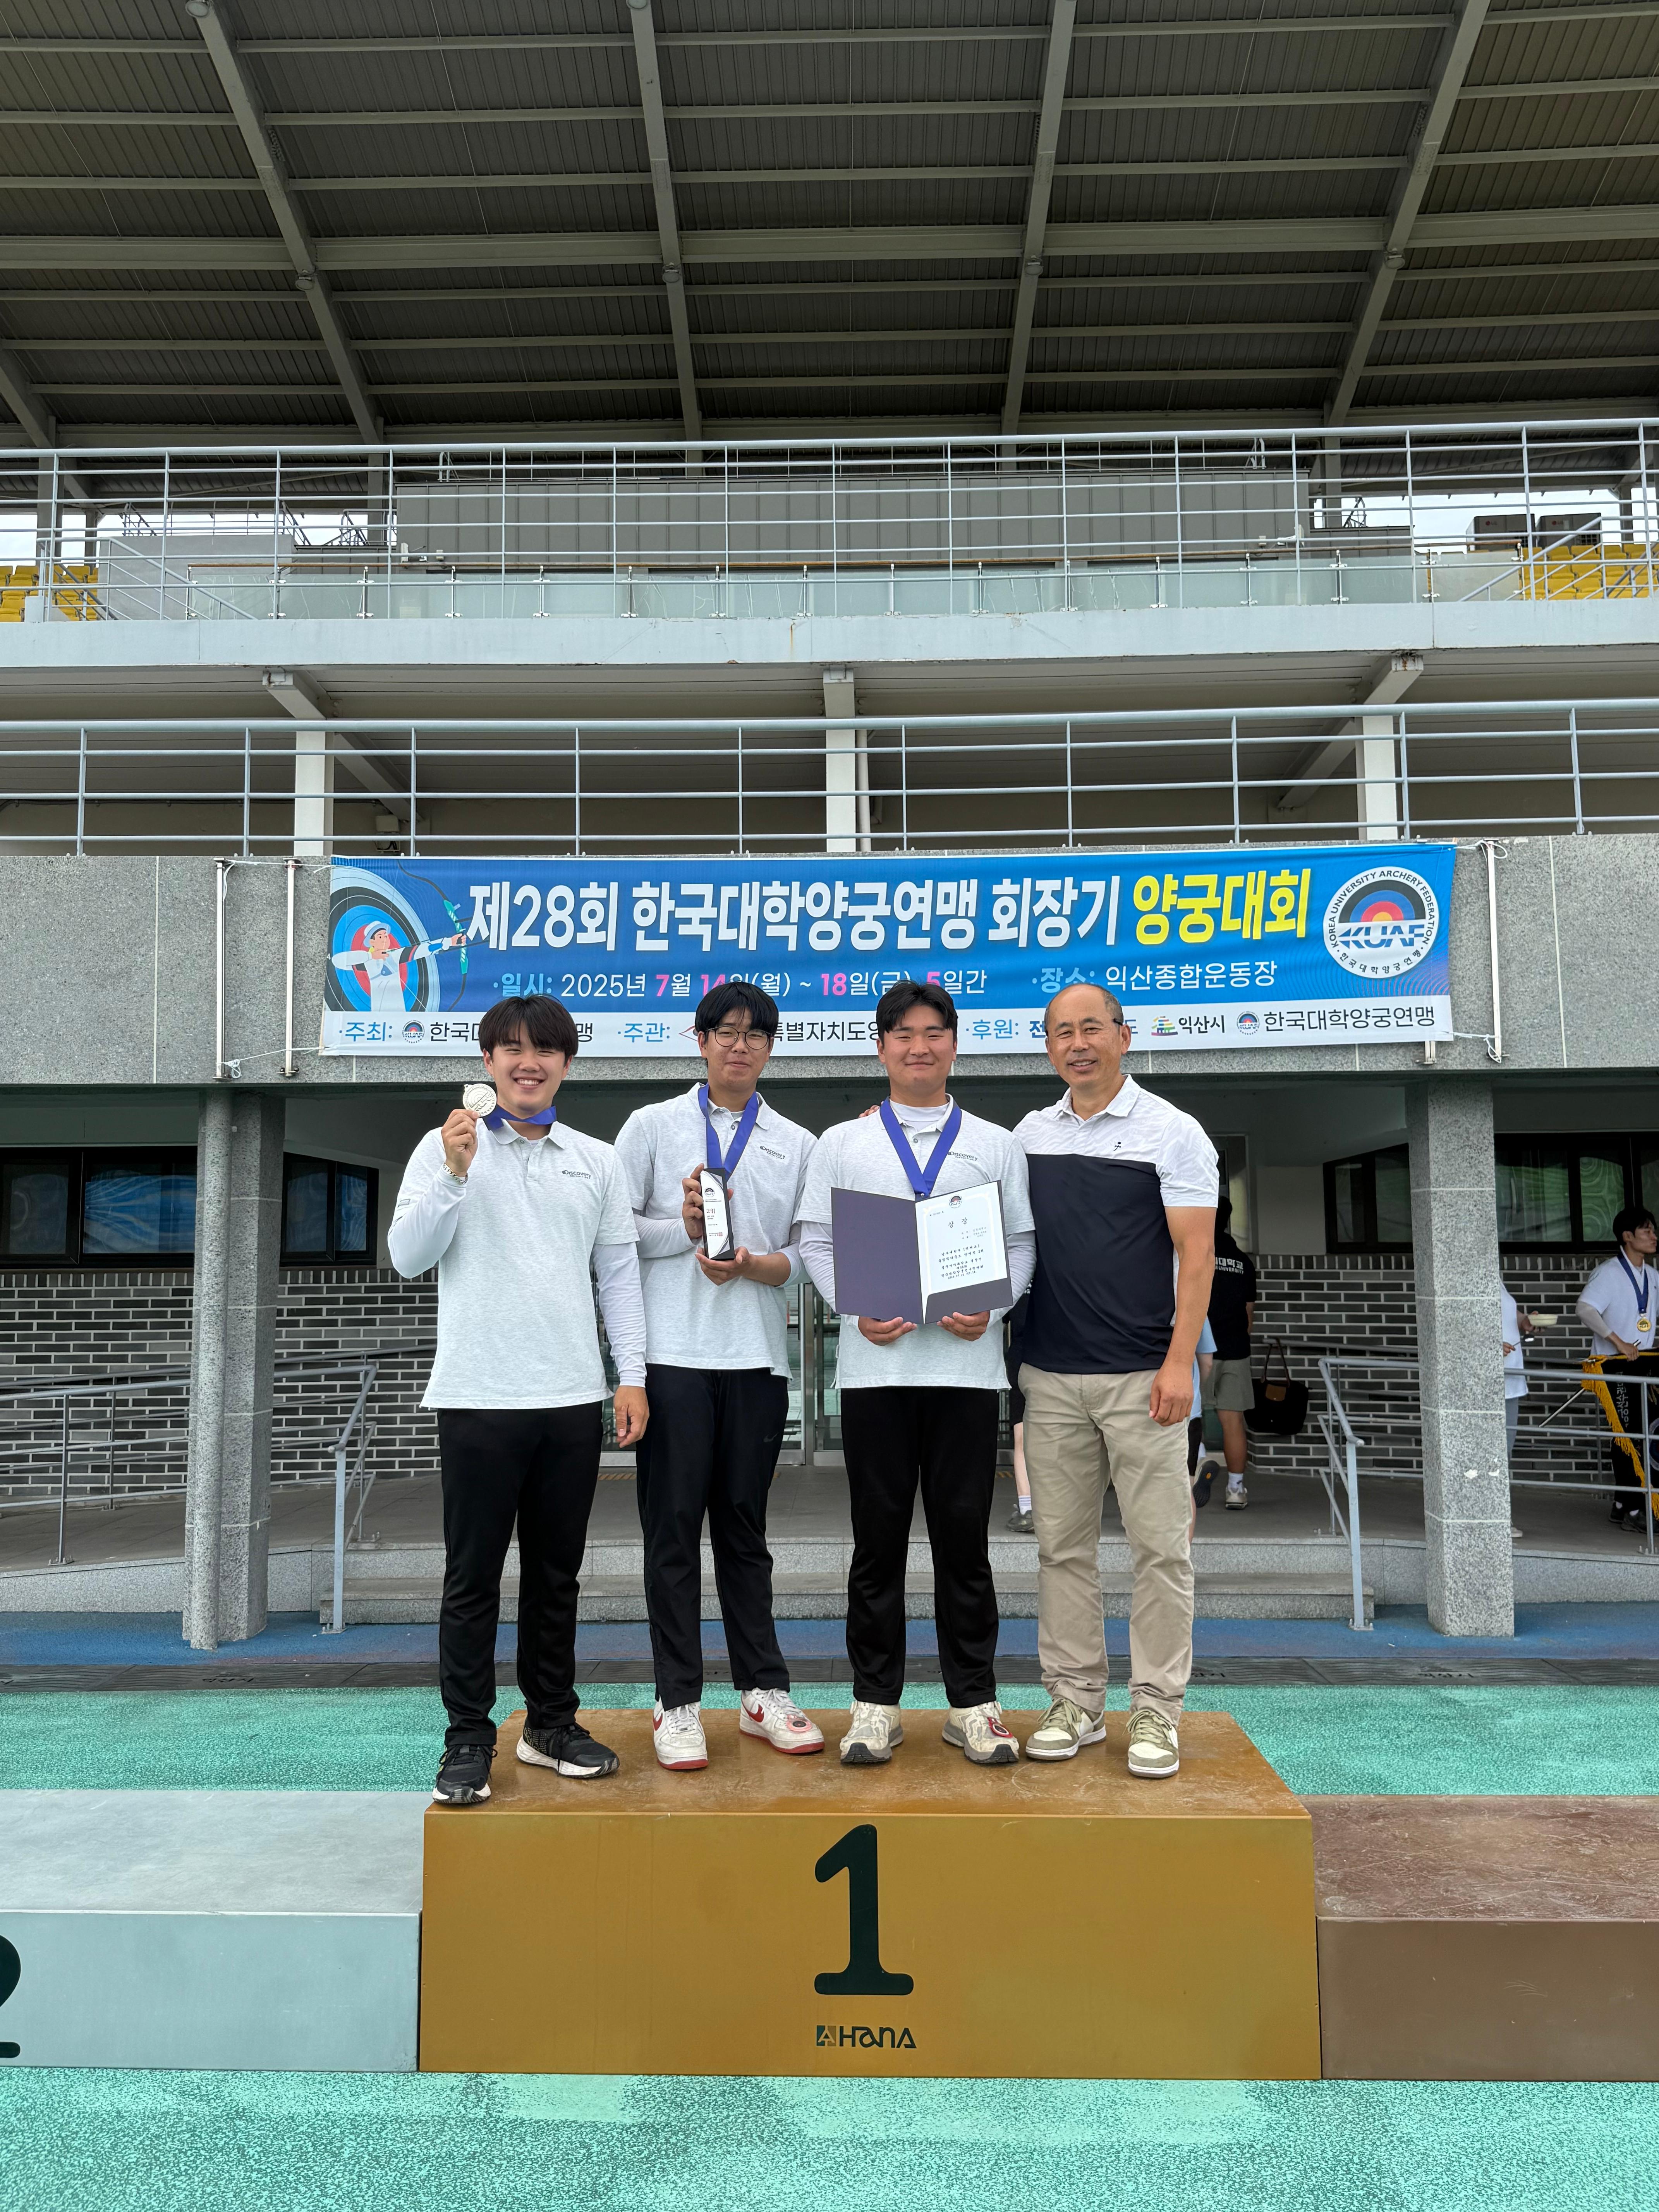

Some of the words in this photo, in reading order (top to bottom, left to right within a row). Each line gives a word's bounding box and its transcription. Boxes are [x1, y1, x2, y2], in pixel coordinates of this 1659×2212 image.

[1331, 872, 1376, 914] UNIVERSITY
[1379, 870, 1423, 886] ARCHERY
[467, 881, 618, 951] 제28회
[633, 879, 977, 951] 한국대학양궁연맹
[988, 876, 1120, 947] 회장기
[1133, 868, 1310, 945] 양궁대회
[1420, 886, 1435, 945] FEDERATION
[1328, 916, 1339, 948] KOREA
[1338, 924, 1425, 950] KUAF
[561, 974, 646, 998] 2025년
[656, 974, 691, 997] 7월
[1106, 961, 1278, 991] 익산종합운동장
[1179, 1015, 1225, 1034] 익산시
[1264, 1007, 1435, 1033] 한국대학양궁연맹
[814, 1824, 914, 1996] 1
